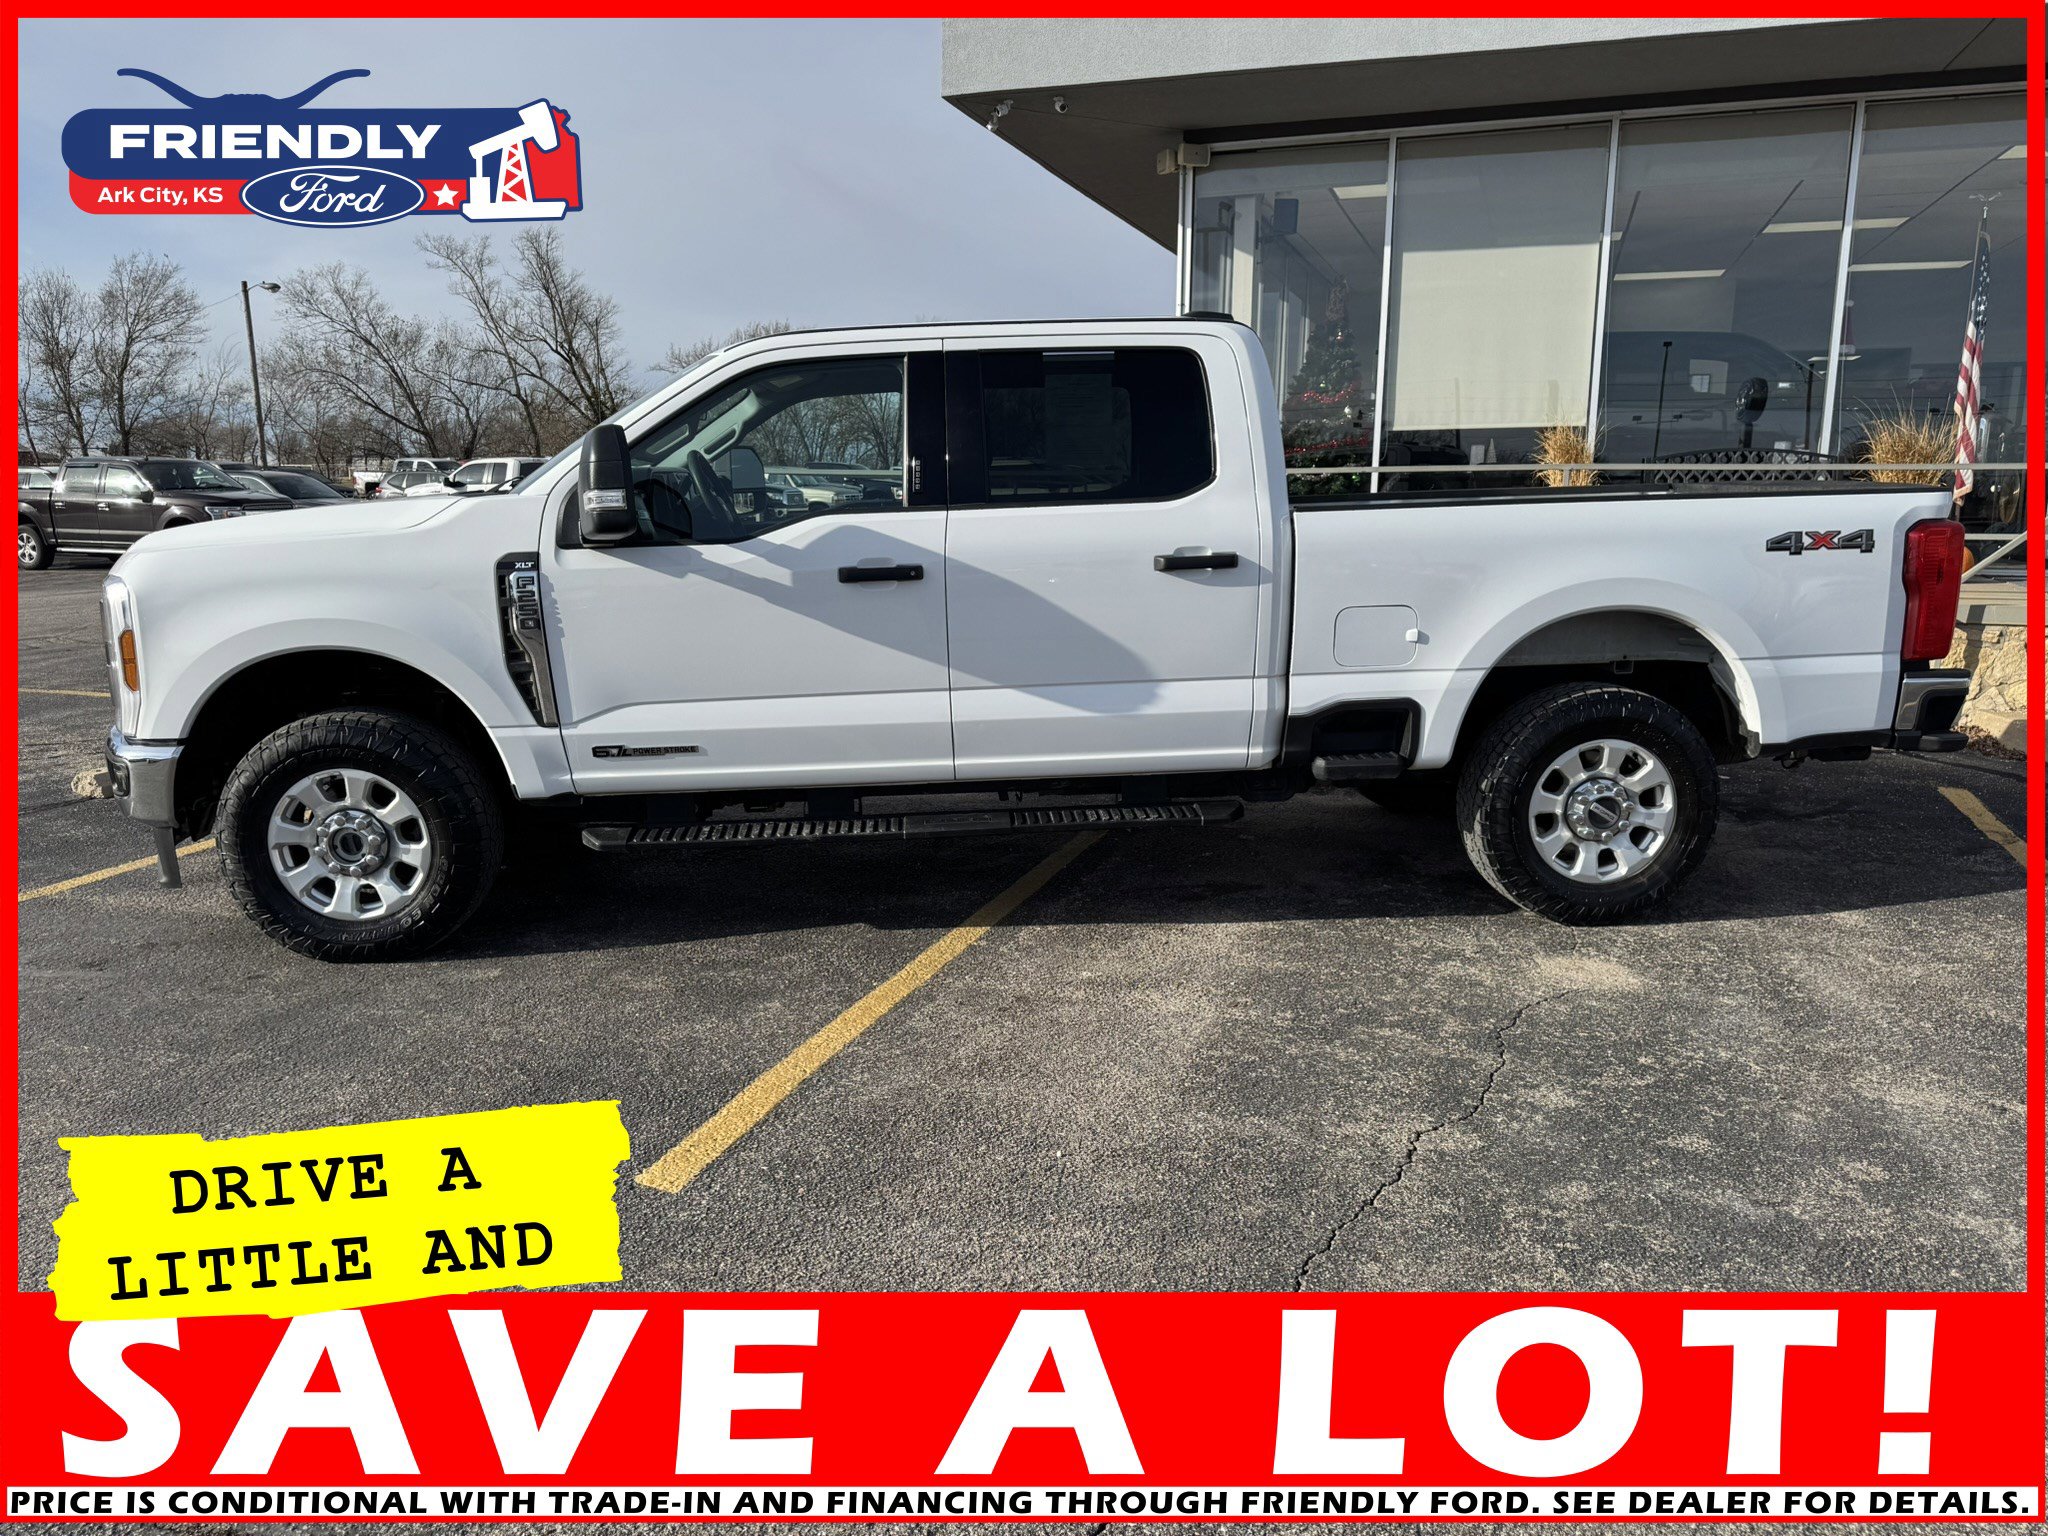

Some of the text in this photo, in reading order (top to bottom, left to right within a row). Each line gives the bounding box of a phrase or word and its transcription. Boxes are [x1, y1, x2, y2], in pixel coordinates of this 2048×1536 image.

[514, 561, 535, 569] XLT
[633, 747, 661, 756] POWER
[663, 745, 697, 754] STROKE
